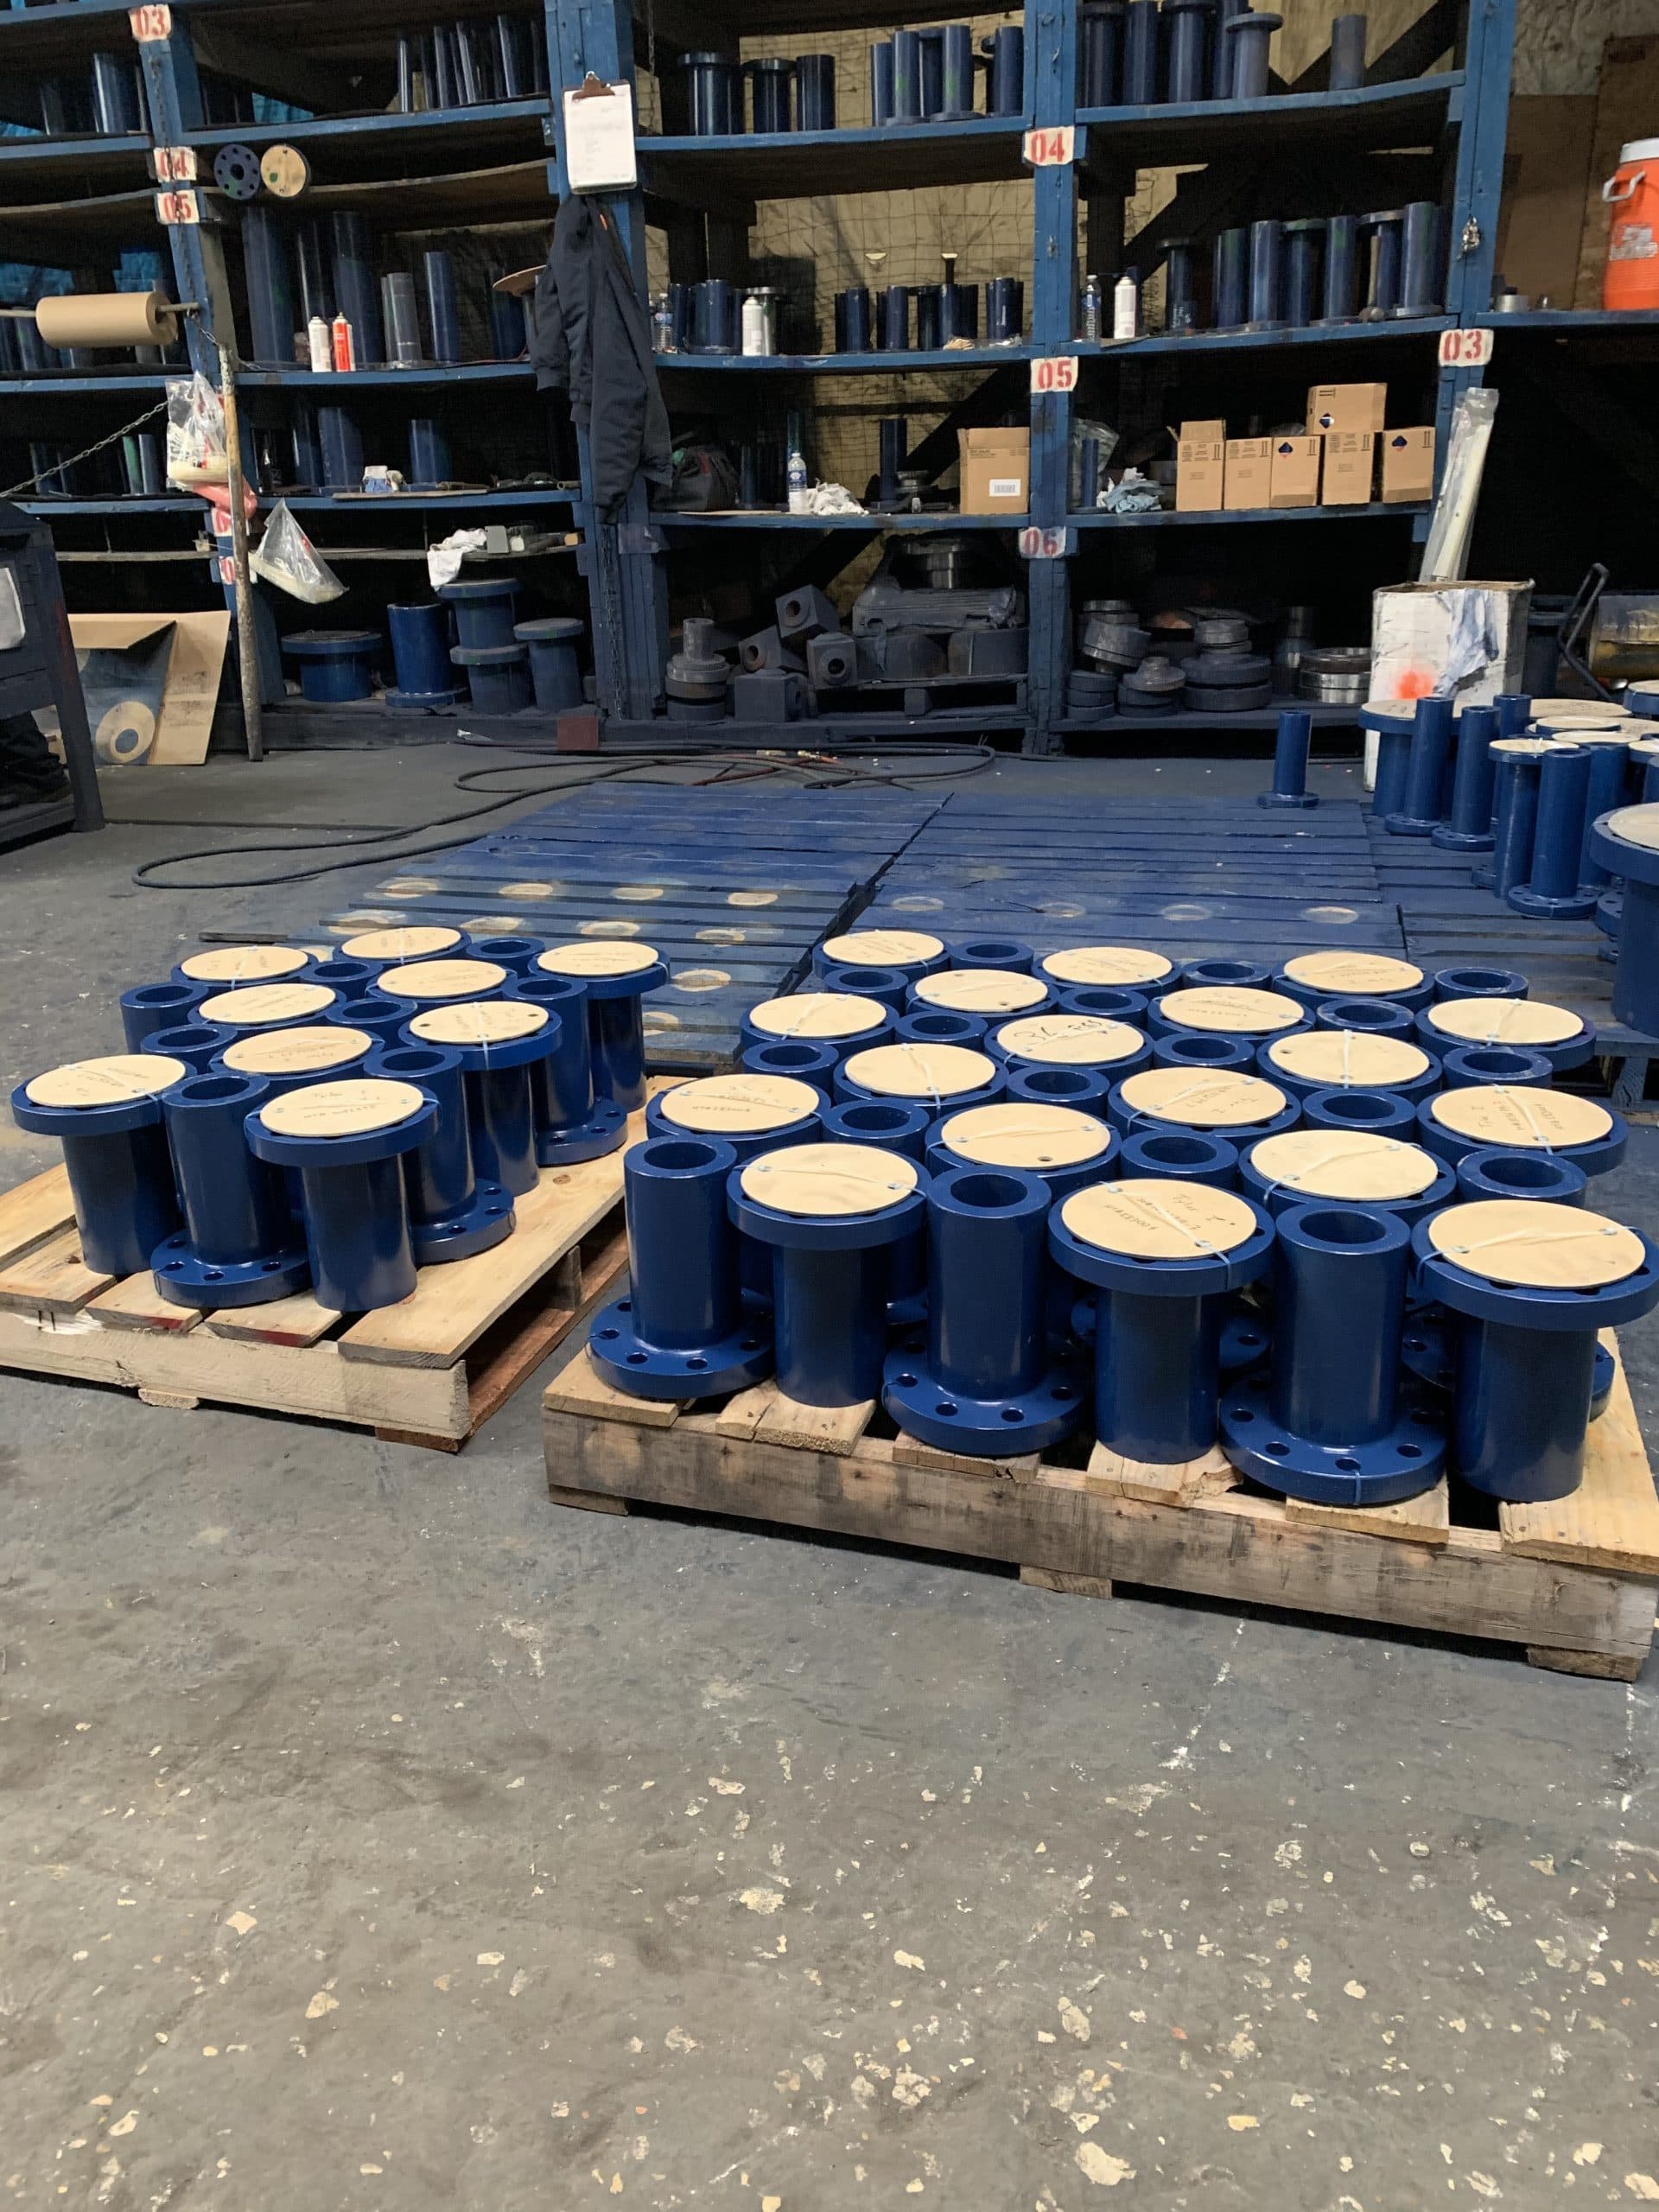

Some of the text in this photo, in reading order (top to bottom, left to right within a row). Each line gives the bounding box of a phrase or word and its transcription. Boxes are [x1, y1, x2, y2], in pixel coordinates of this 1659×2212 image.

[133, 9, 166, 36] 03
[1031, 130, 1065, 162] 04
[163, 193, 192, 221] 05
[1443, 330, 1483, 360] 03
[1038, 359, 1072, 389] 05
[1025, 529, 1058, 556] 06
